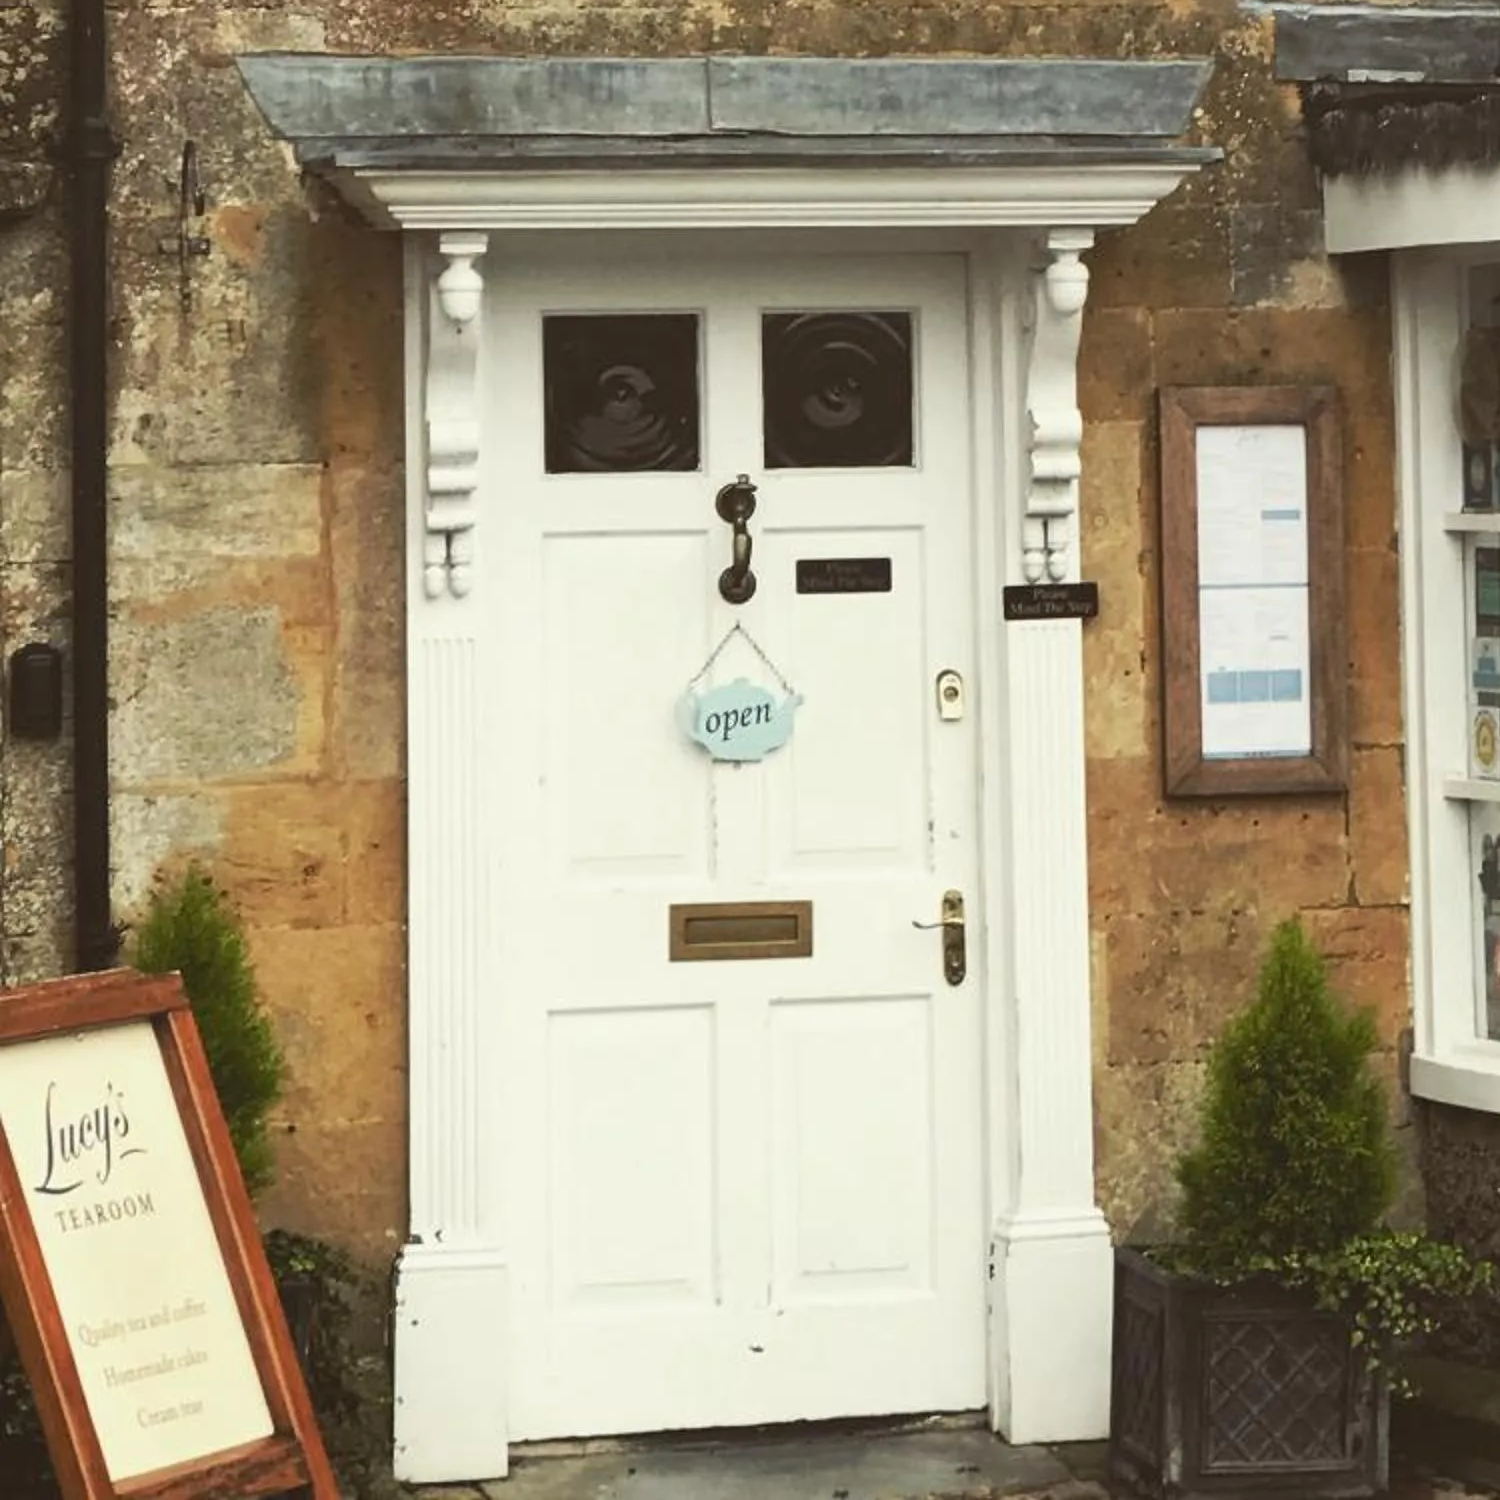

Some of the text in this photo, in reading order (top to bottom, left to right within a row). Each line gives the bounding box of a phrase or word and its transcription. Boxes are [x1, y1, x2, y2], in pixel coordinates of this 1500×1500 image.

[705, 701, 773, 742] open
[33, 1080, 130, 1196] Lucy's
[53, 1192, 156, 1234] TEAROOM
